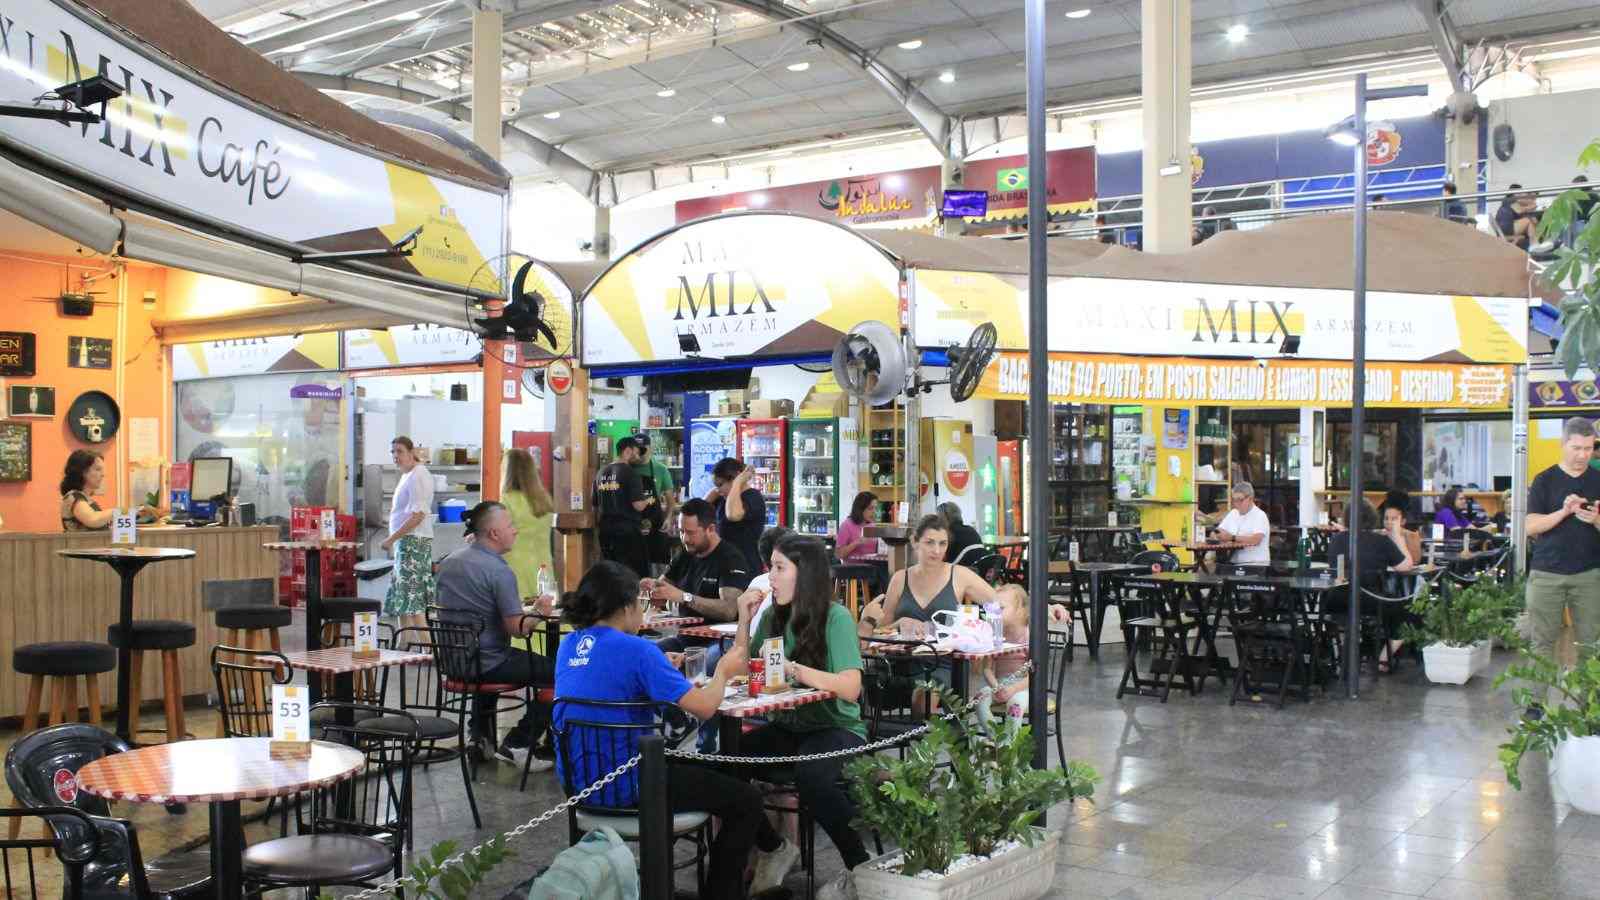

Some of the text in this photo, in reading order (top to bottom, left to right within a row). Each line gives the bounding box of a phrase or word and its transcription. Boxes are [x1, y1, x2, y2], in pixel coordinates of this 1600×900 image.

[56, 30, 176, 177] MIX
[198, 116, 291, 205] Café
[673, 269, 777, 321] MIX
[1192, 297, 1295, 344] MIX
[1312, 318, 1416, 336] ARMZEM
[999, 357, 1072, 395] BACHAU
[1074, 361, 1094, 397] DO
[1146, 363, 1164, 399] EM
[1167, 363, 1206, 400] POSTA
[1210, 364, 1265, 401] SALGADO
[1280, 366, 1316, 402] LOMBO
[1319, 367, 1393, 403] DESSGADO
[1400, 368, 1454, 403] DESFIADO
[117, 518, 132, 530] 55
[359, 625, 372, 637] 51
[769, 651, 781, 666] 52
[280, 702, 301, 718] 53
